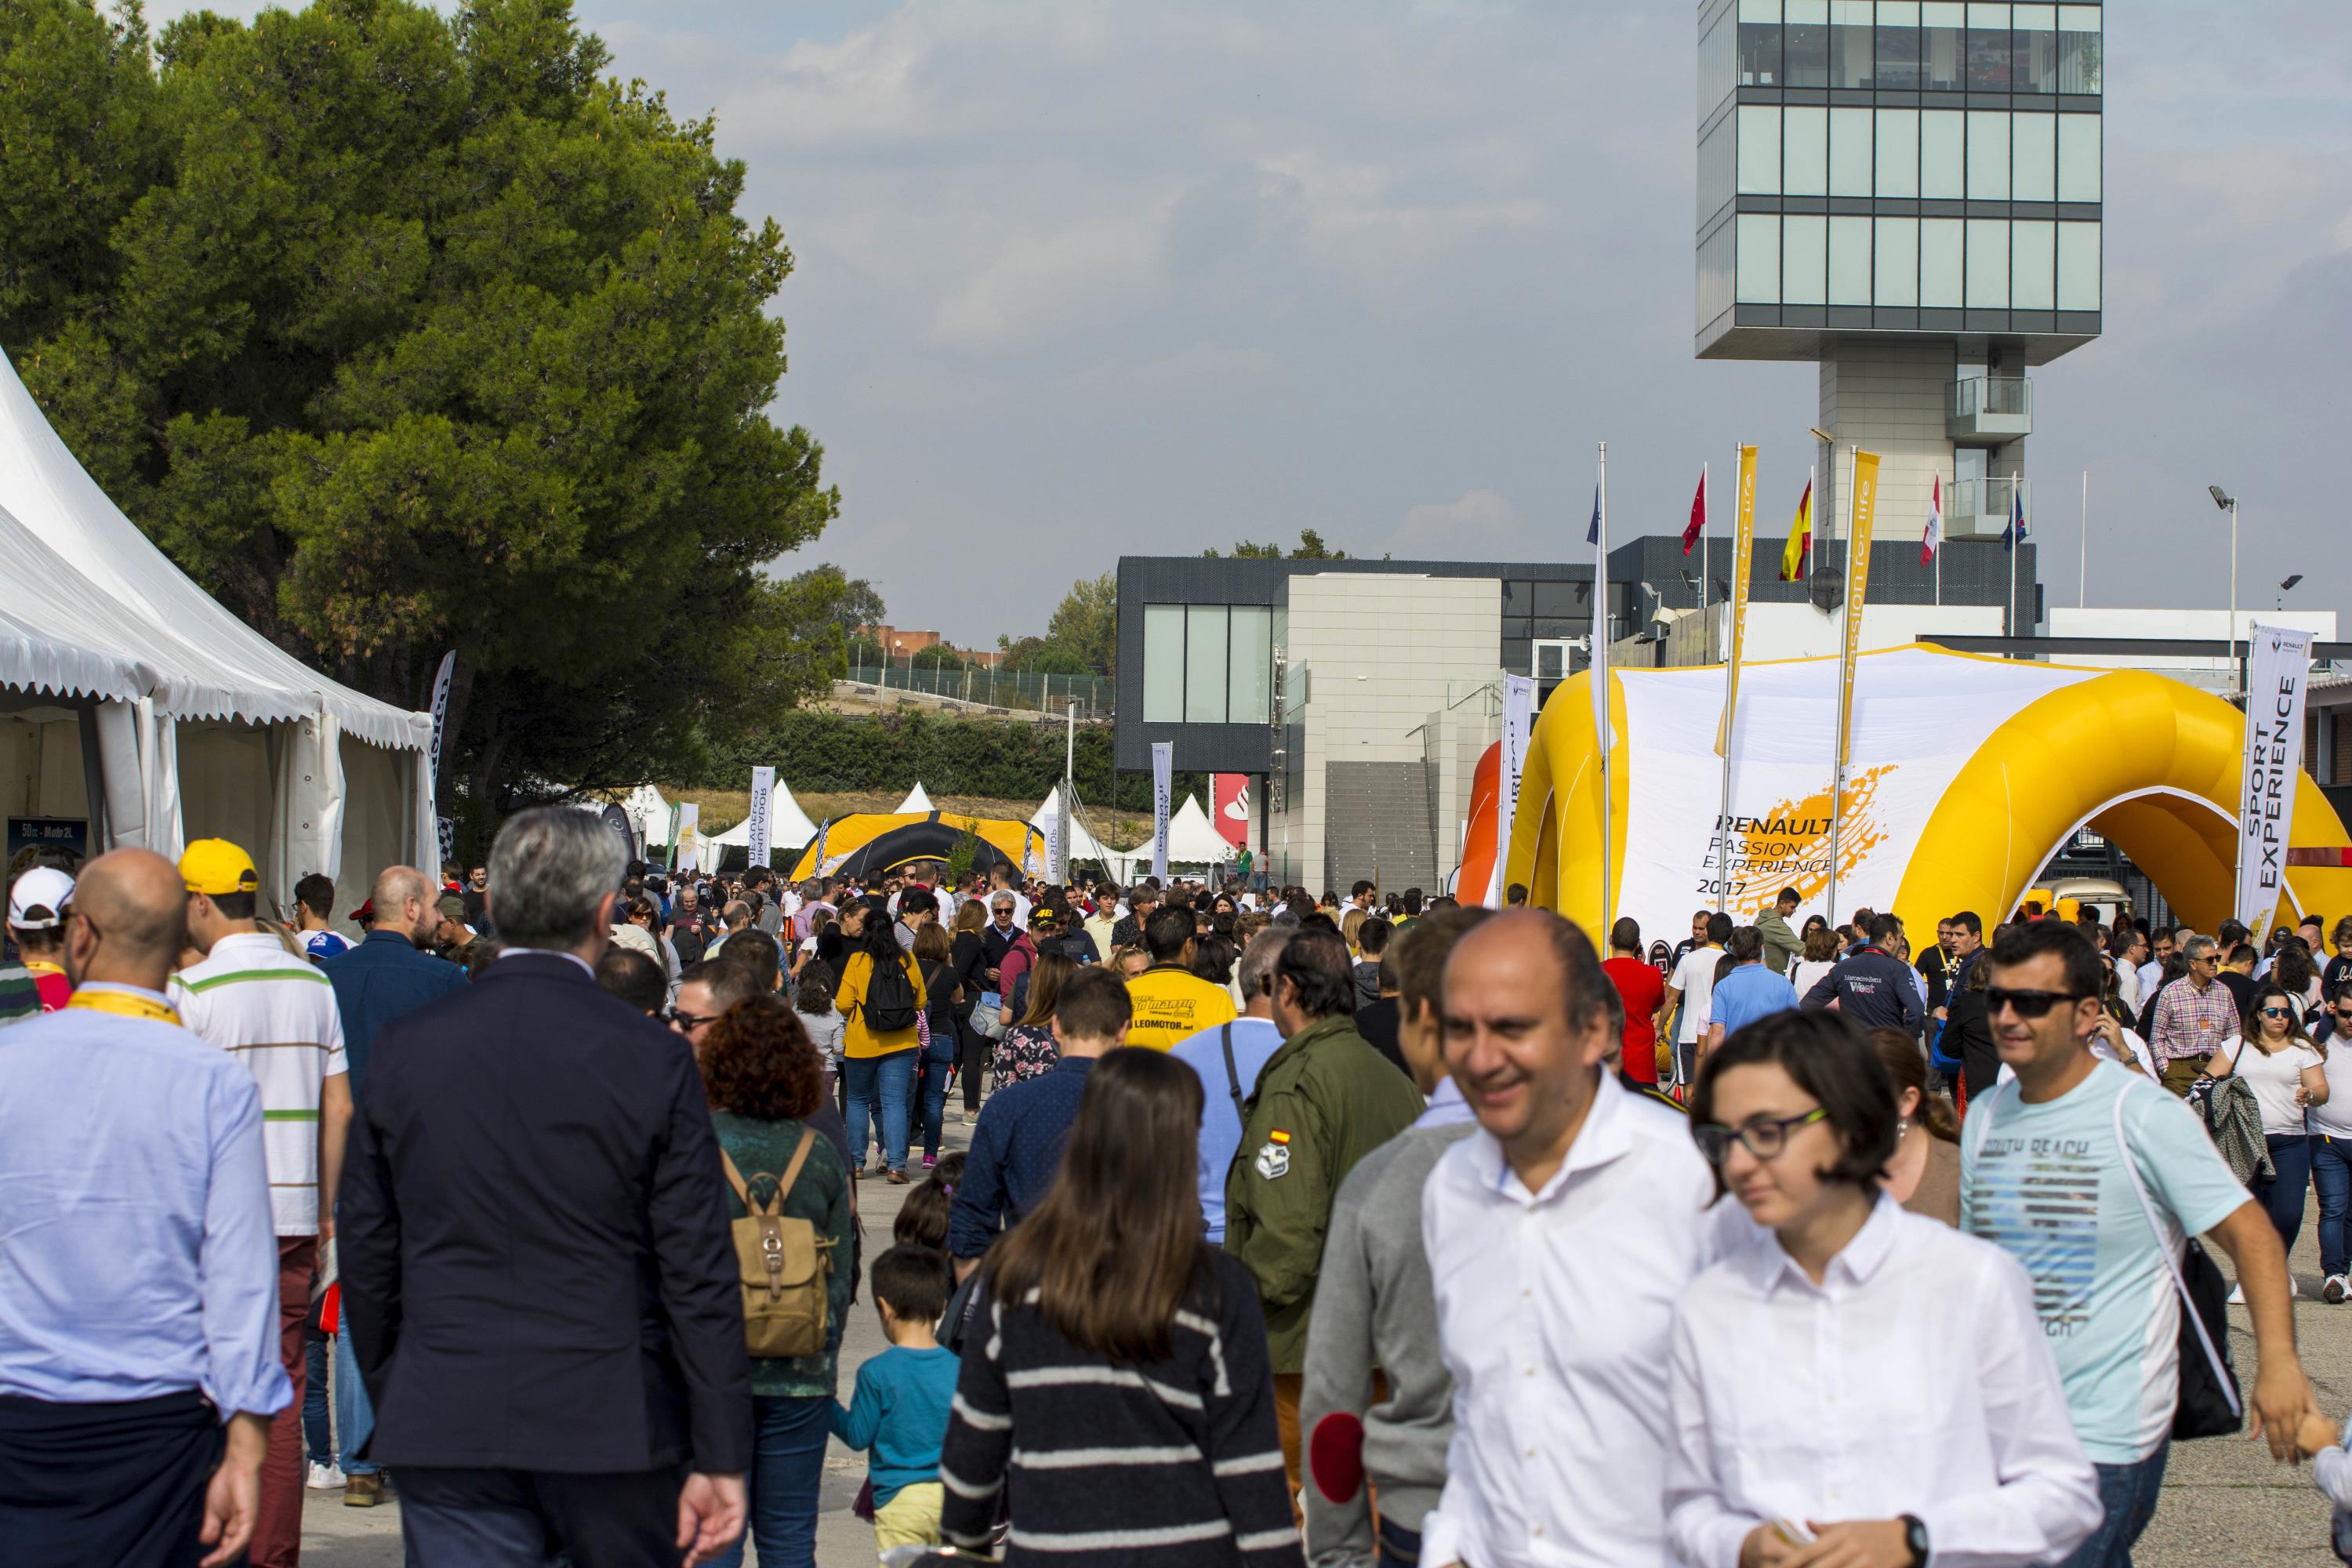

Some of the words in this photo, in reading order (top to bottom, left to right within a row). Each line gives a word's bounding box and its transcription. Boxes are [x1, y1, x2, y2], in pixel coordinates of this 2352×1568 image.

[1858, 480, 1870, 520] life
[1856, 528, 1865, 567] for
[1846, 572, 1864, 684] passion
[2248, 722, 2268, 837] SPORT
[2259, 676, 2295, 889] EXPERIENCE
[1715, 815, 1834, 835] RENAULT
[1708, 837, 1802, 856] PASSION
[1702, 855, 1832, 873] EXPERIENCE
[1697, 879, 1747, 896] 2017
[1036, 909, 1053, 917] 46
[1844, 975, 1882, 983] Mercedes-Benz
[1849, 982, 1875, 994] West
[1134, 1019, 1193, 1031] LEOMOTOR.net
